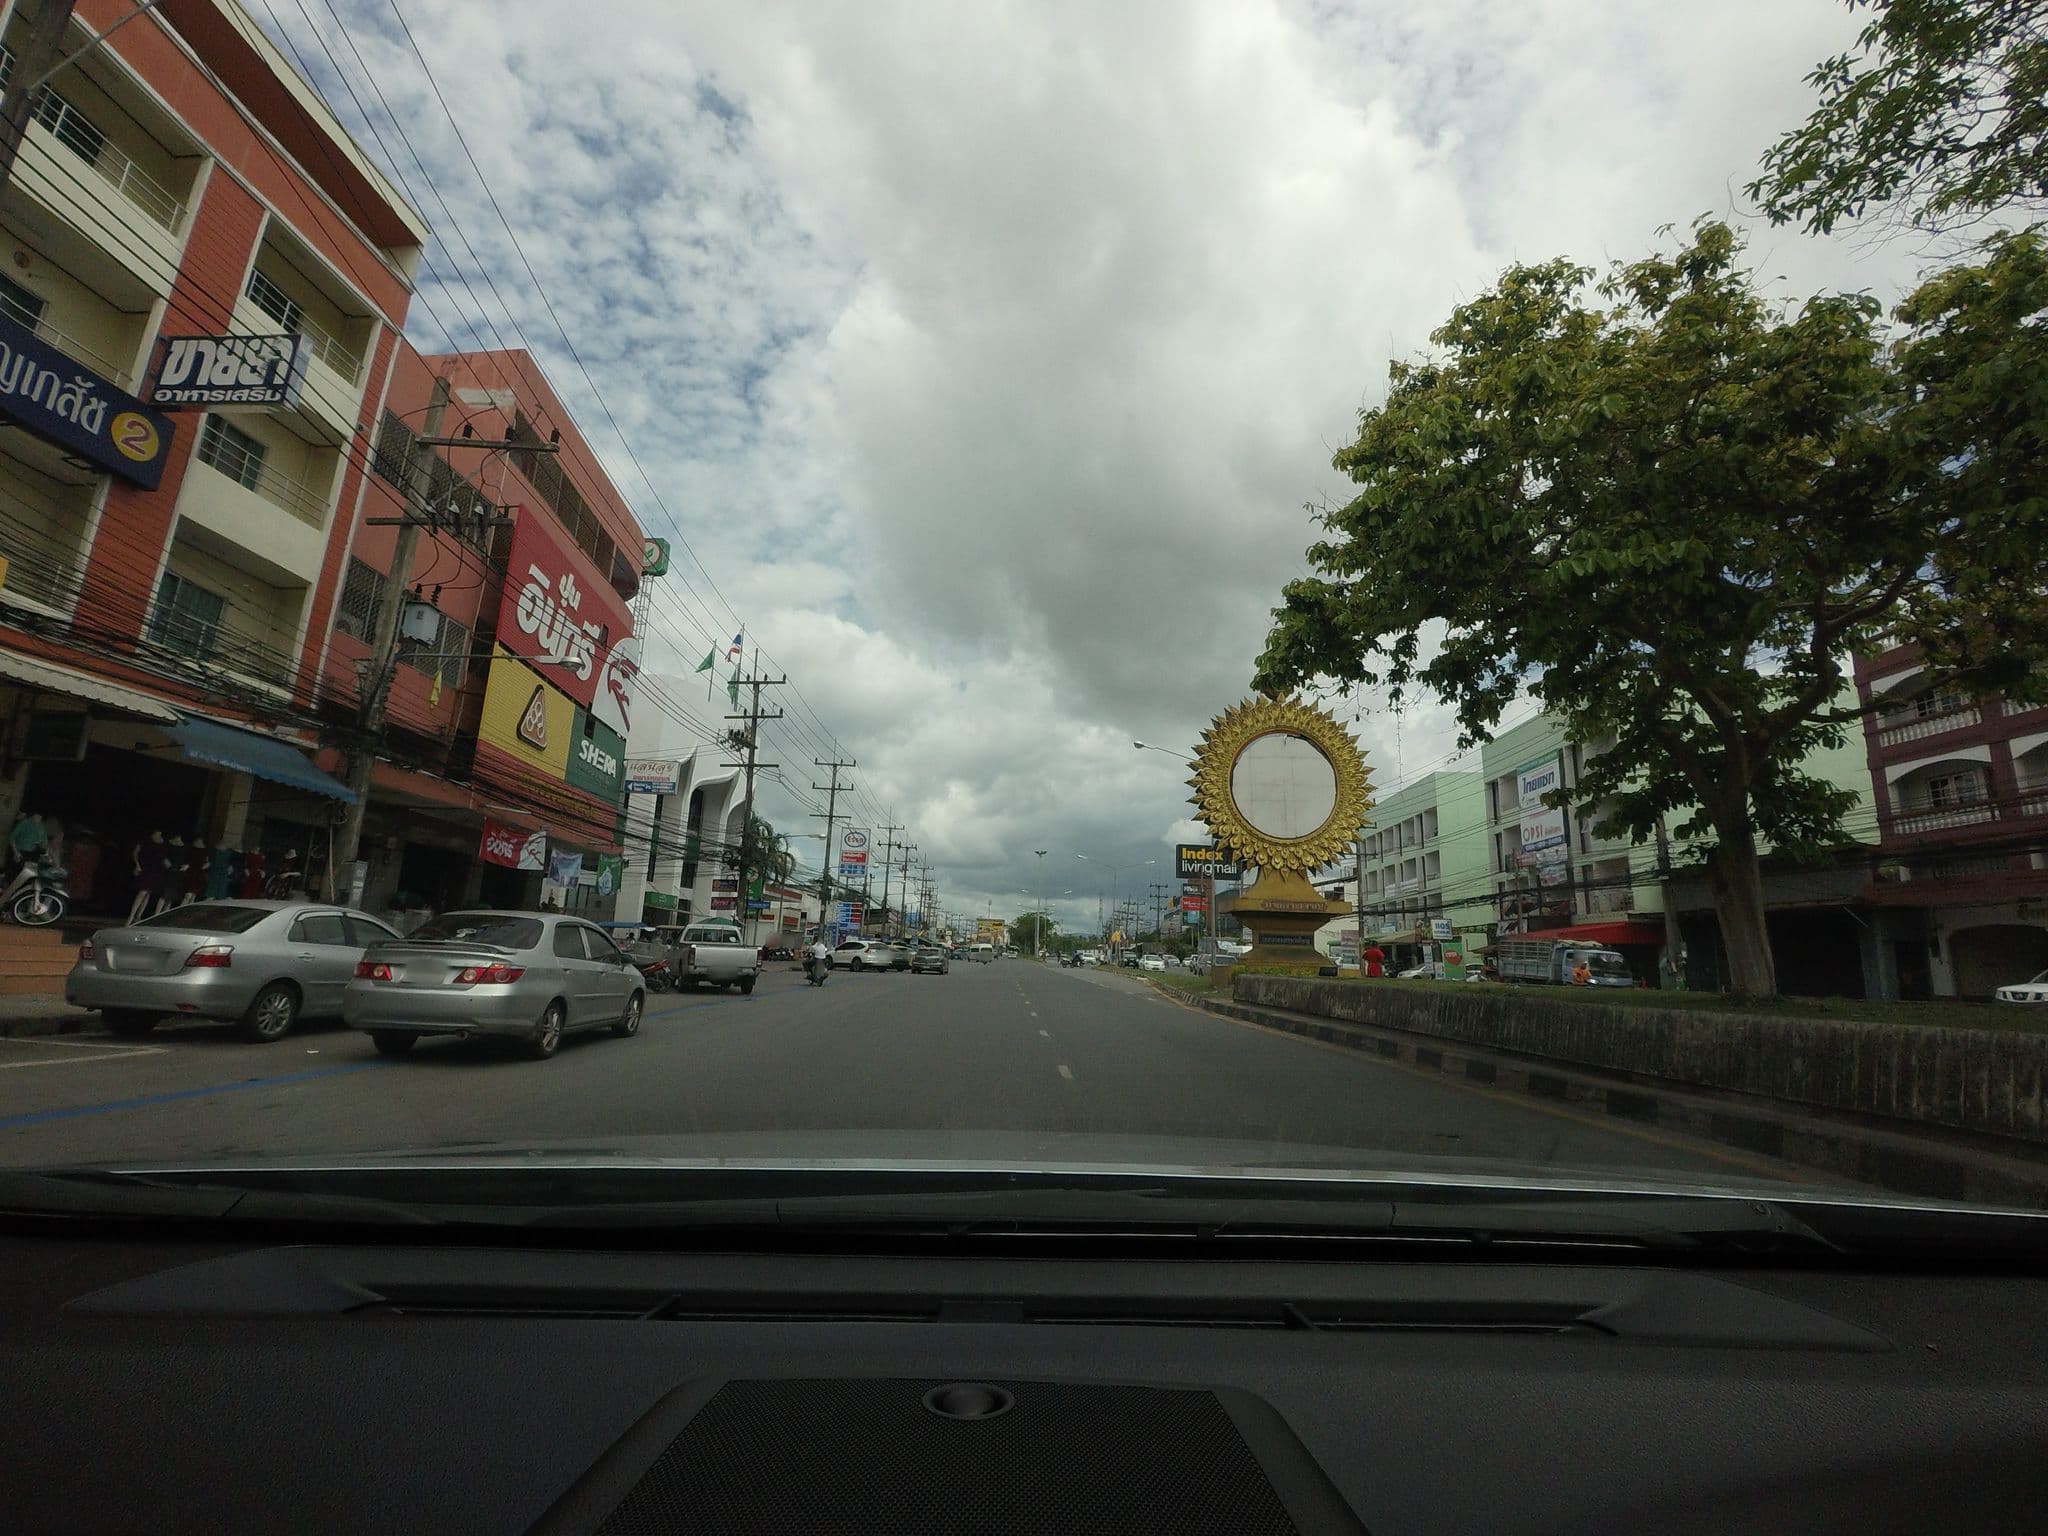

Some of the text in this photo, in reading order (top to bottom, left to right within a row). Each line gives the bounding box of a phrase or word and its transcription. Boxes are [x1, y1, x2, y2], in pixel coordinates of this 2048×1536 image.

[159, 338, 294, 386] ขายยา
[154, 386, 284, 403] อาหารเสริม
[517, 563, 602, 681] อินทรี
[578, 739, 617, 779] SHERA
[1181, 848, 1224, 860] Index
